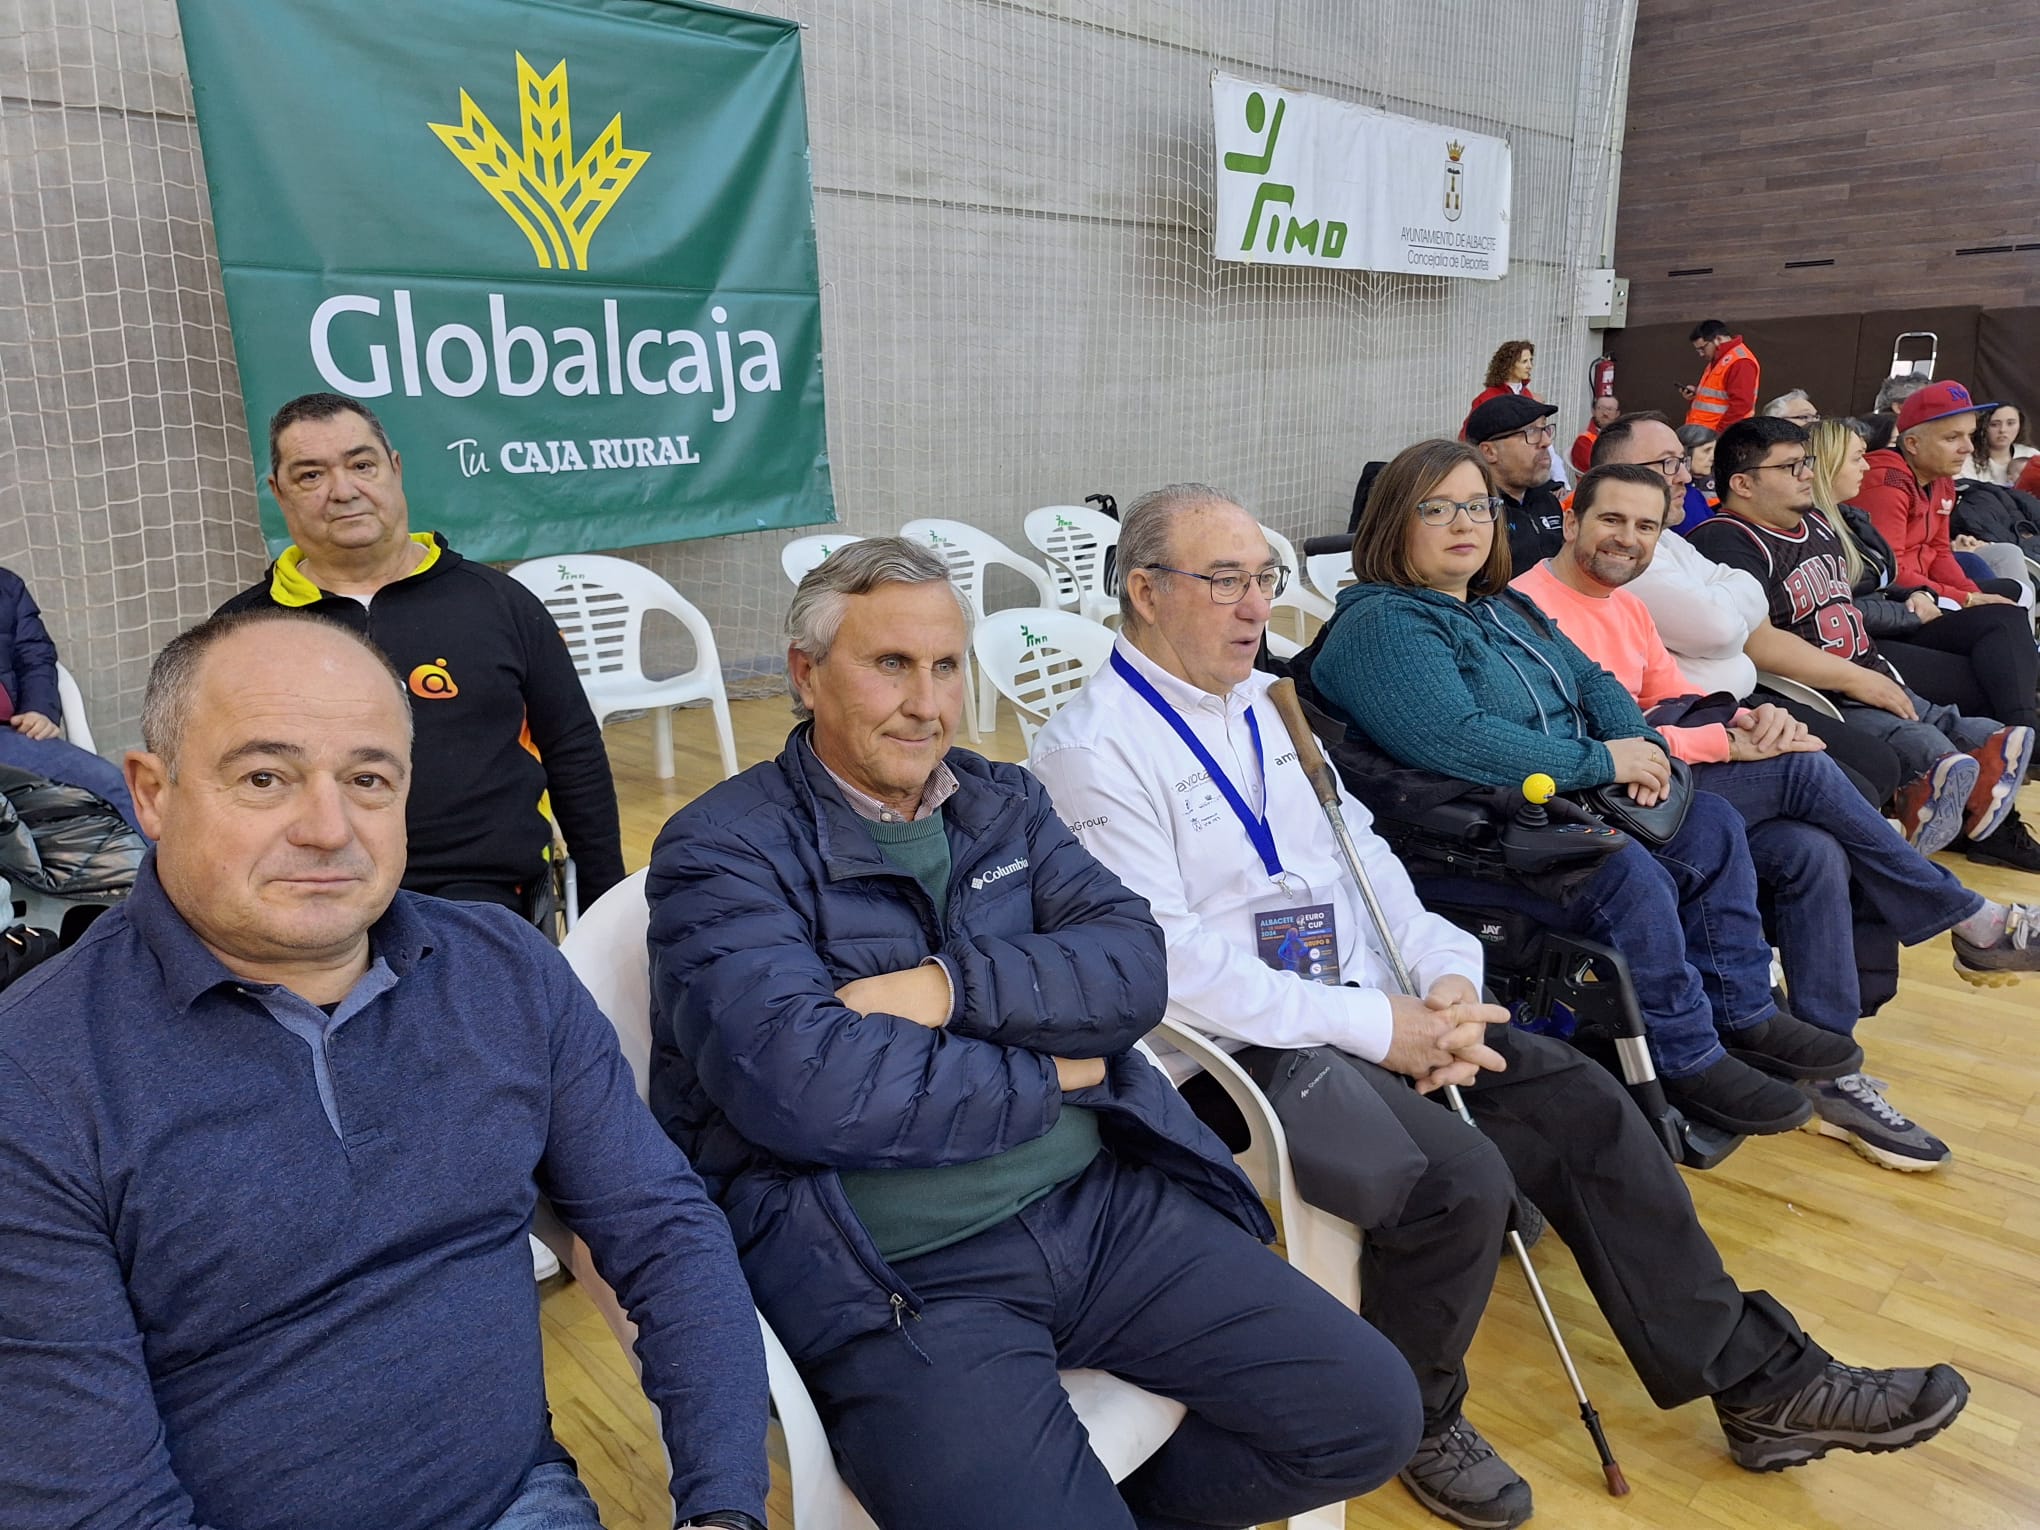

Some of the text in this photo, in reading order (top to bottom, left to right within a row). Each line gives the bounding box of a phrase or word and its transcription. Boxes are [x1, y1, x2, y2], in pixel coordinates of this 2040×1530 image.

[1401, 226, 1497, 252] AYUNTAMIENTO DE ALBACETE
[1448, 256, 1460, 269] de
[1460, 254, 1489, 271] Deportes
[309, 289, 782, 423] Globalcaja
[446, 435, 701, 478] Tu CAJA RURAL
[1814, 602, 1870, 660] 91
[982, 857, 1029, 884] Columbia
[1260, 916, 1294, 927] ALBACETE
[1305, 912, 1325, 921] EURO
[1307, 920, 1324, 929] CUP
[1480, 924, 1502, 935] JAY
